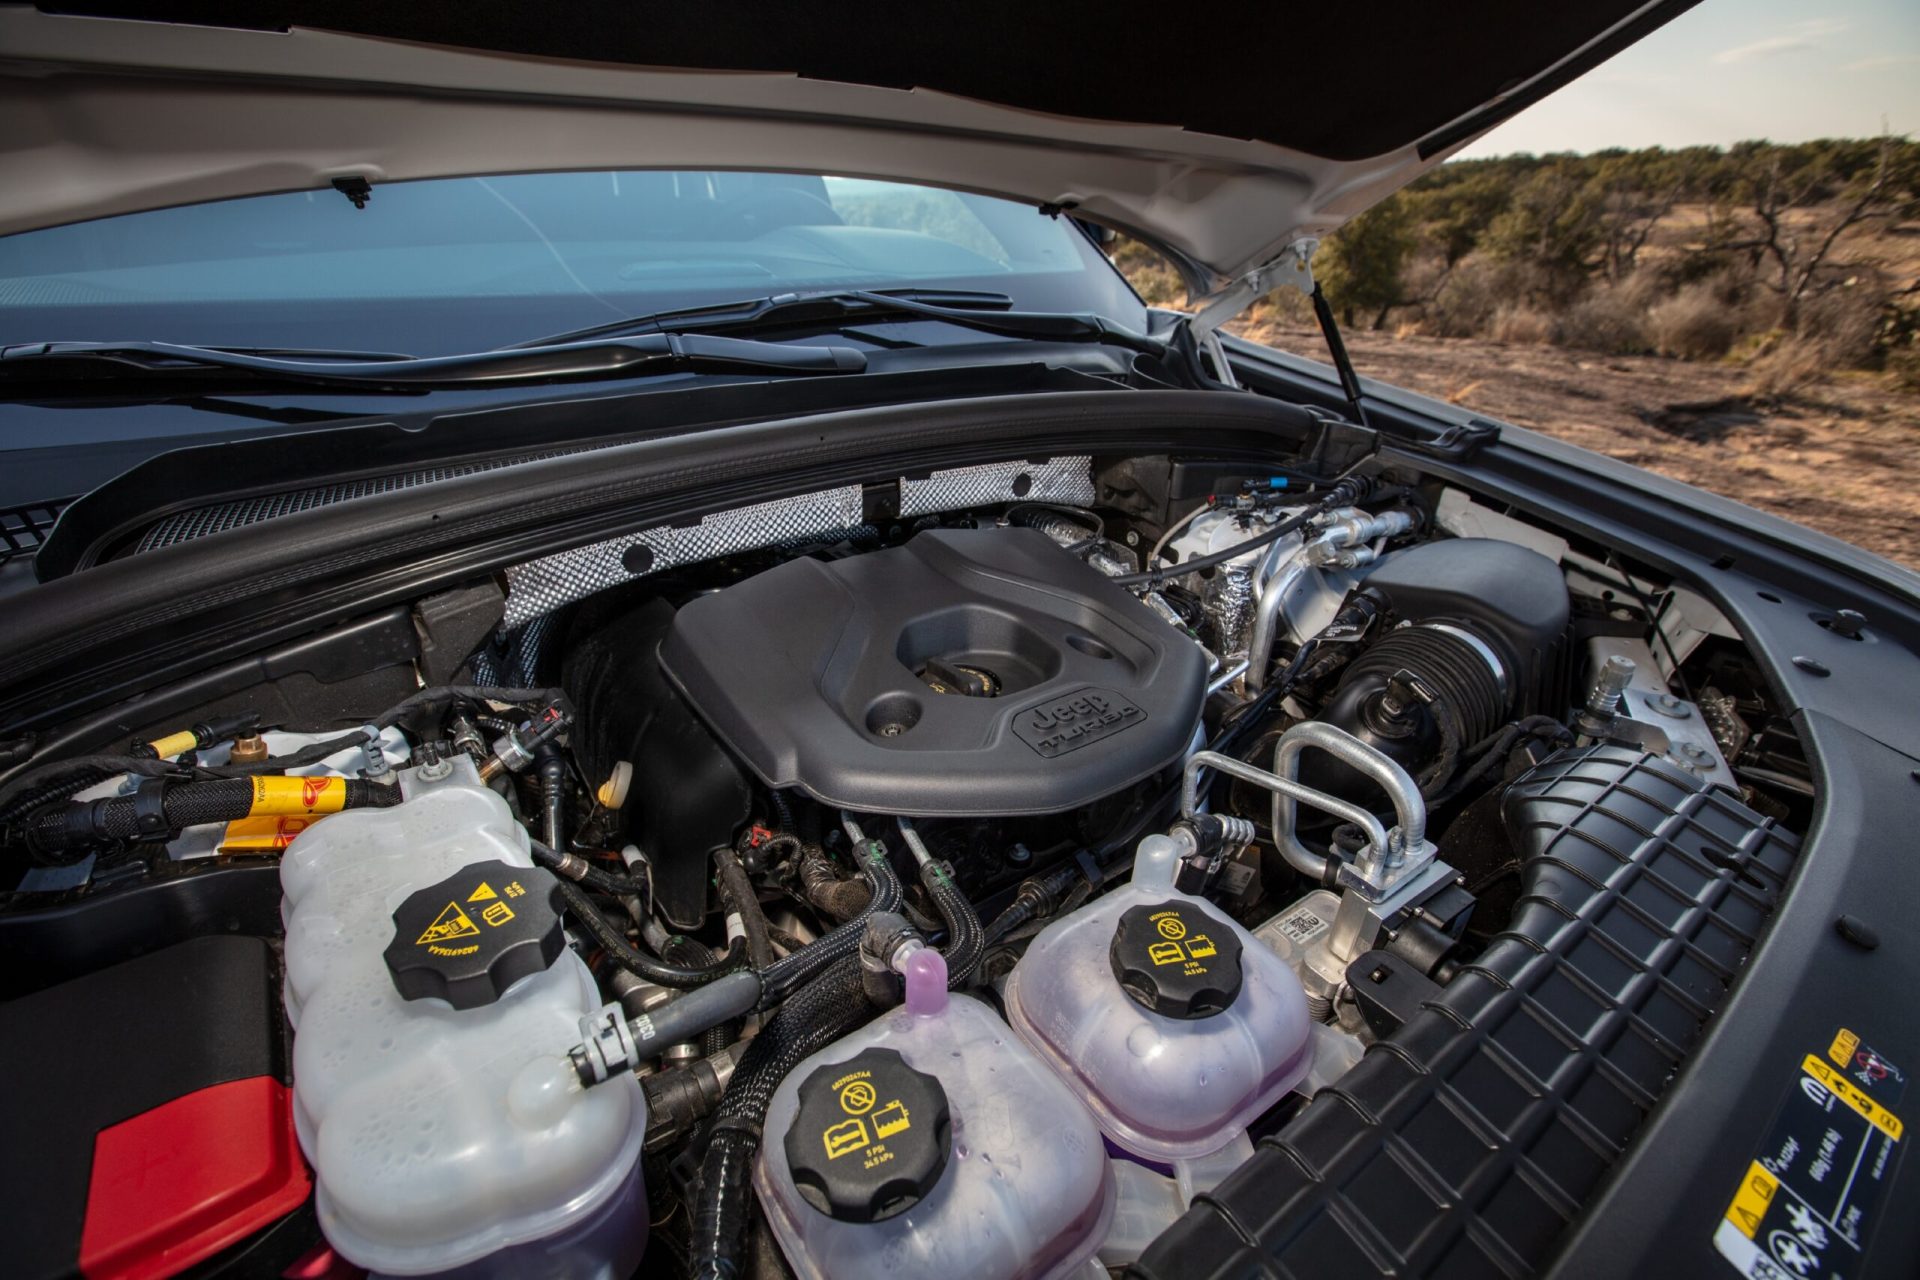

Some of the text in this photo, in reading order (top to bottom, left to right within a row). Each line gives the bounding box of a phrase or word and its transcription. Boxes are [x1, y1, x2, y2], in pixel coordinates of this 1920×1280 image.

[1032, 694, 1110, 730] Jeep
[1038, 705, 1140, 748] TURBO
[864, 1153, 894, 1169] 34.5 kPa
[866, 1144, 885, 1158] 5 PSI
